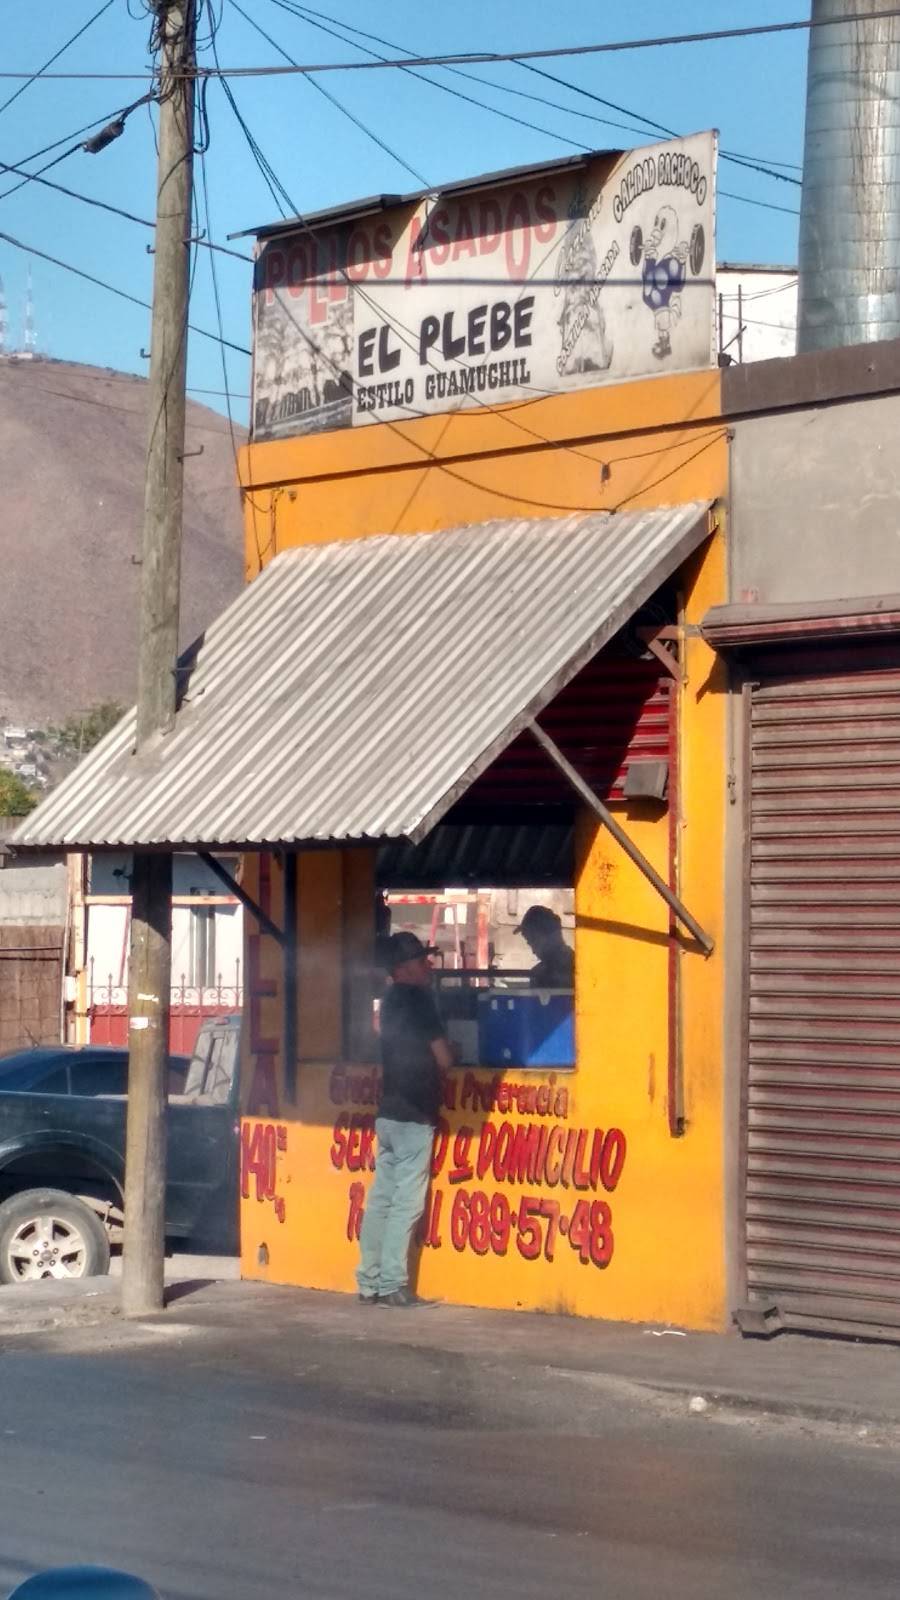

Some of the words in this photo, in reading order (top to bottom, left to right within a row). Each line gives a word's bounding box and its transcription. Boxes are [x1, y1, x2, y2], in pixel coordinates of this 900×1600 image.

[613, 156, 657, 223] CALIDAD
[657, 152, 708, 206] BACHOCO
[264, 225, 394, 328] POLLOS
[403, 187, 558, 290] ASADOS
[358, 325, 402, 378] EL
[419, 295, 536, 366] PLEBE
[357, 377, 415, 413] ESTILO
[425, 357, 532, 401] GUAMUCHIL
[477, 1120, 627, 1191] DOMICILIO
